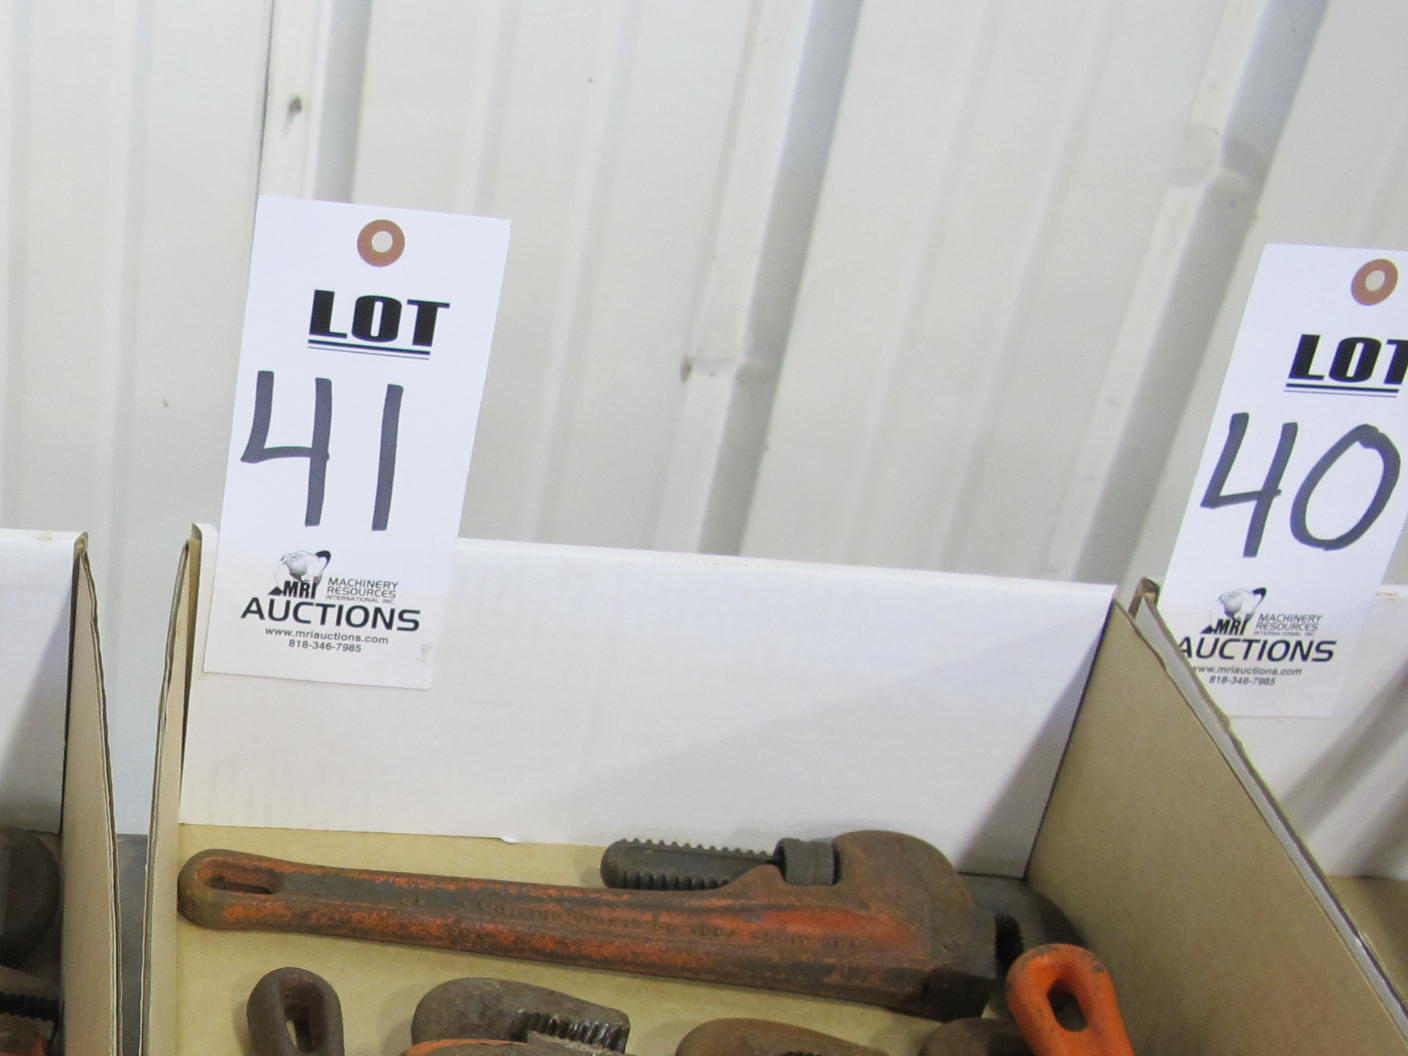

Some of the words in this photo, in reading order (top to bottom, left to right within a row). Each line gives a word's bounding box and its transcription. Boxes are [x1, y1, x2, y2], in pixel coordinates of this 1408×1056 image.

[308, 289, 451, 347] LOT
[1288, 334, 1408, 385] LOT
[240, 370, 405, 532] 41
[1200, 411, 1402, 558] 40
[283, 580, 319, 600] MRI
[326, 586, 397, 599] RESOURCES
[327, 577, 400, 590] MACHINERY
[240, 597, 421, 632] AUCTIONS
[1258, 613, 1323, 623] MACHINERY
[265, 628, 389, 644] www.mriauctions.com
[1214, 618, 1249, 636] MRI
[1255, 622, 1319, 631] RESOURCES
[288, 639, 362, 653] 818-346-7985
[1178, 636, 1338, 662] AUCTIONS
